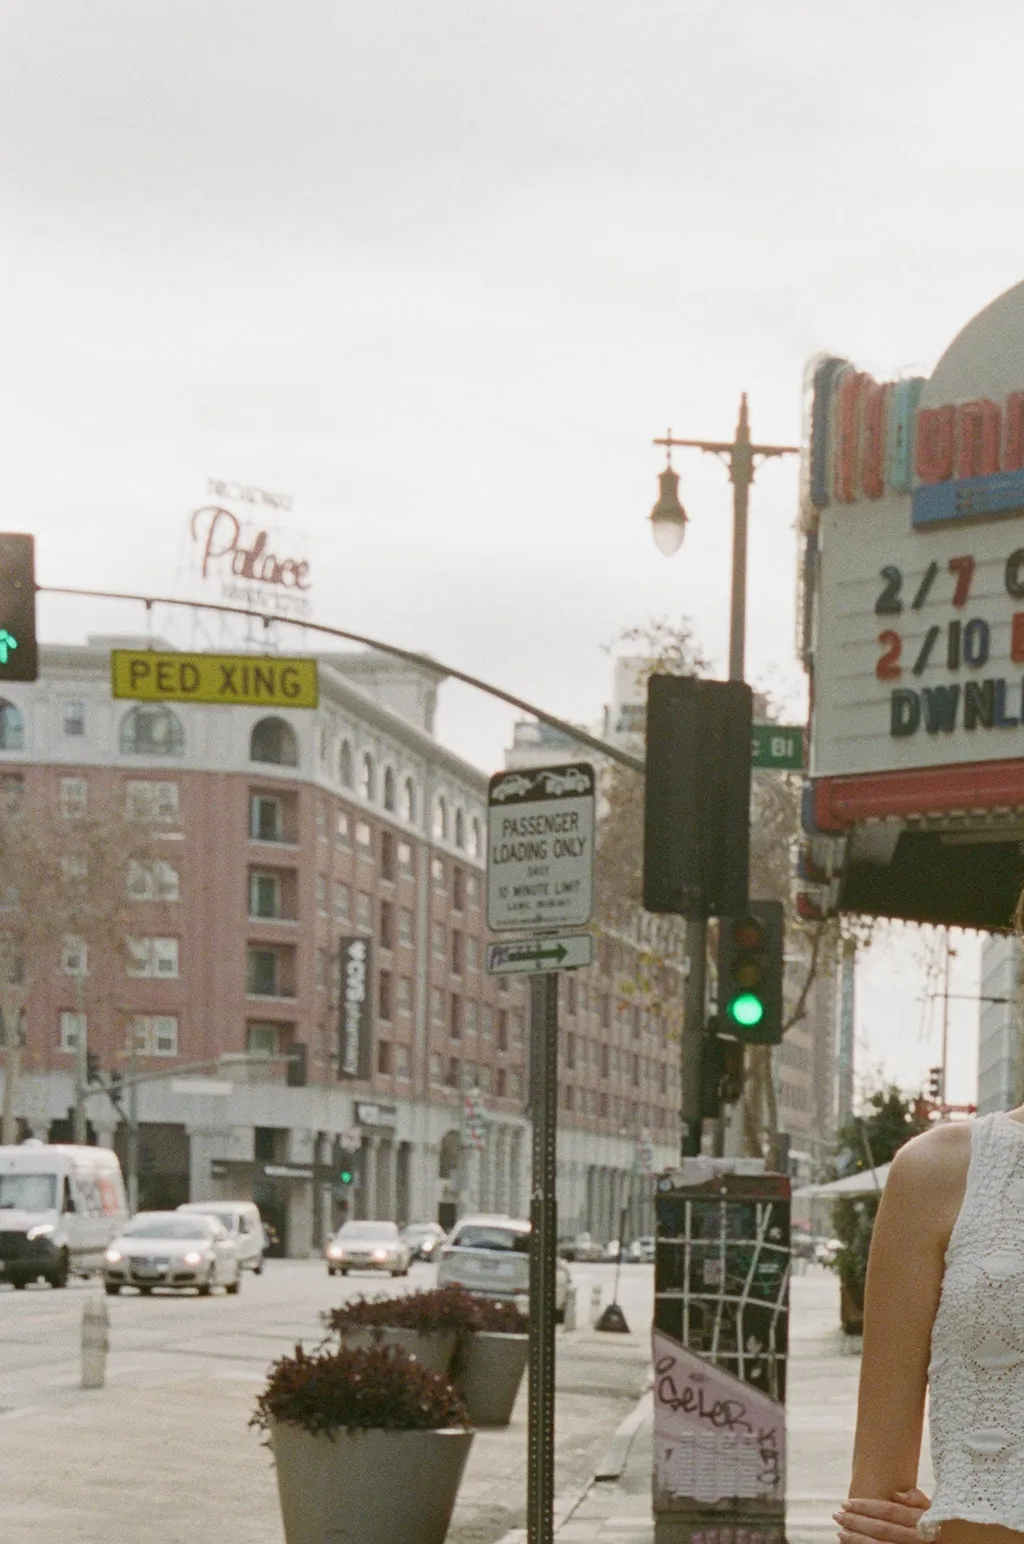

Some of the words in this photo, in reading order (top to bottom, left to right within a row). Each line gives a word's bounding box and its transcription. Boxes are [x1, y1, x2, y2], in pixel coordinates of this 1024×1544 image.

[191, 506, 312, 589] Palace
[875, 555, 974, 615] 2/7
[875, 618, 989, 680] 2/10
[129, 659, 199, 693] PED
[219, 663, 301, 698] XING
[502, 811, 579, 838] PASSENGER
[492, 841, 548, 865] LOADING
[553, 836, 588, 859] ONLY
